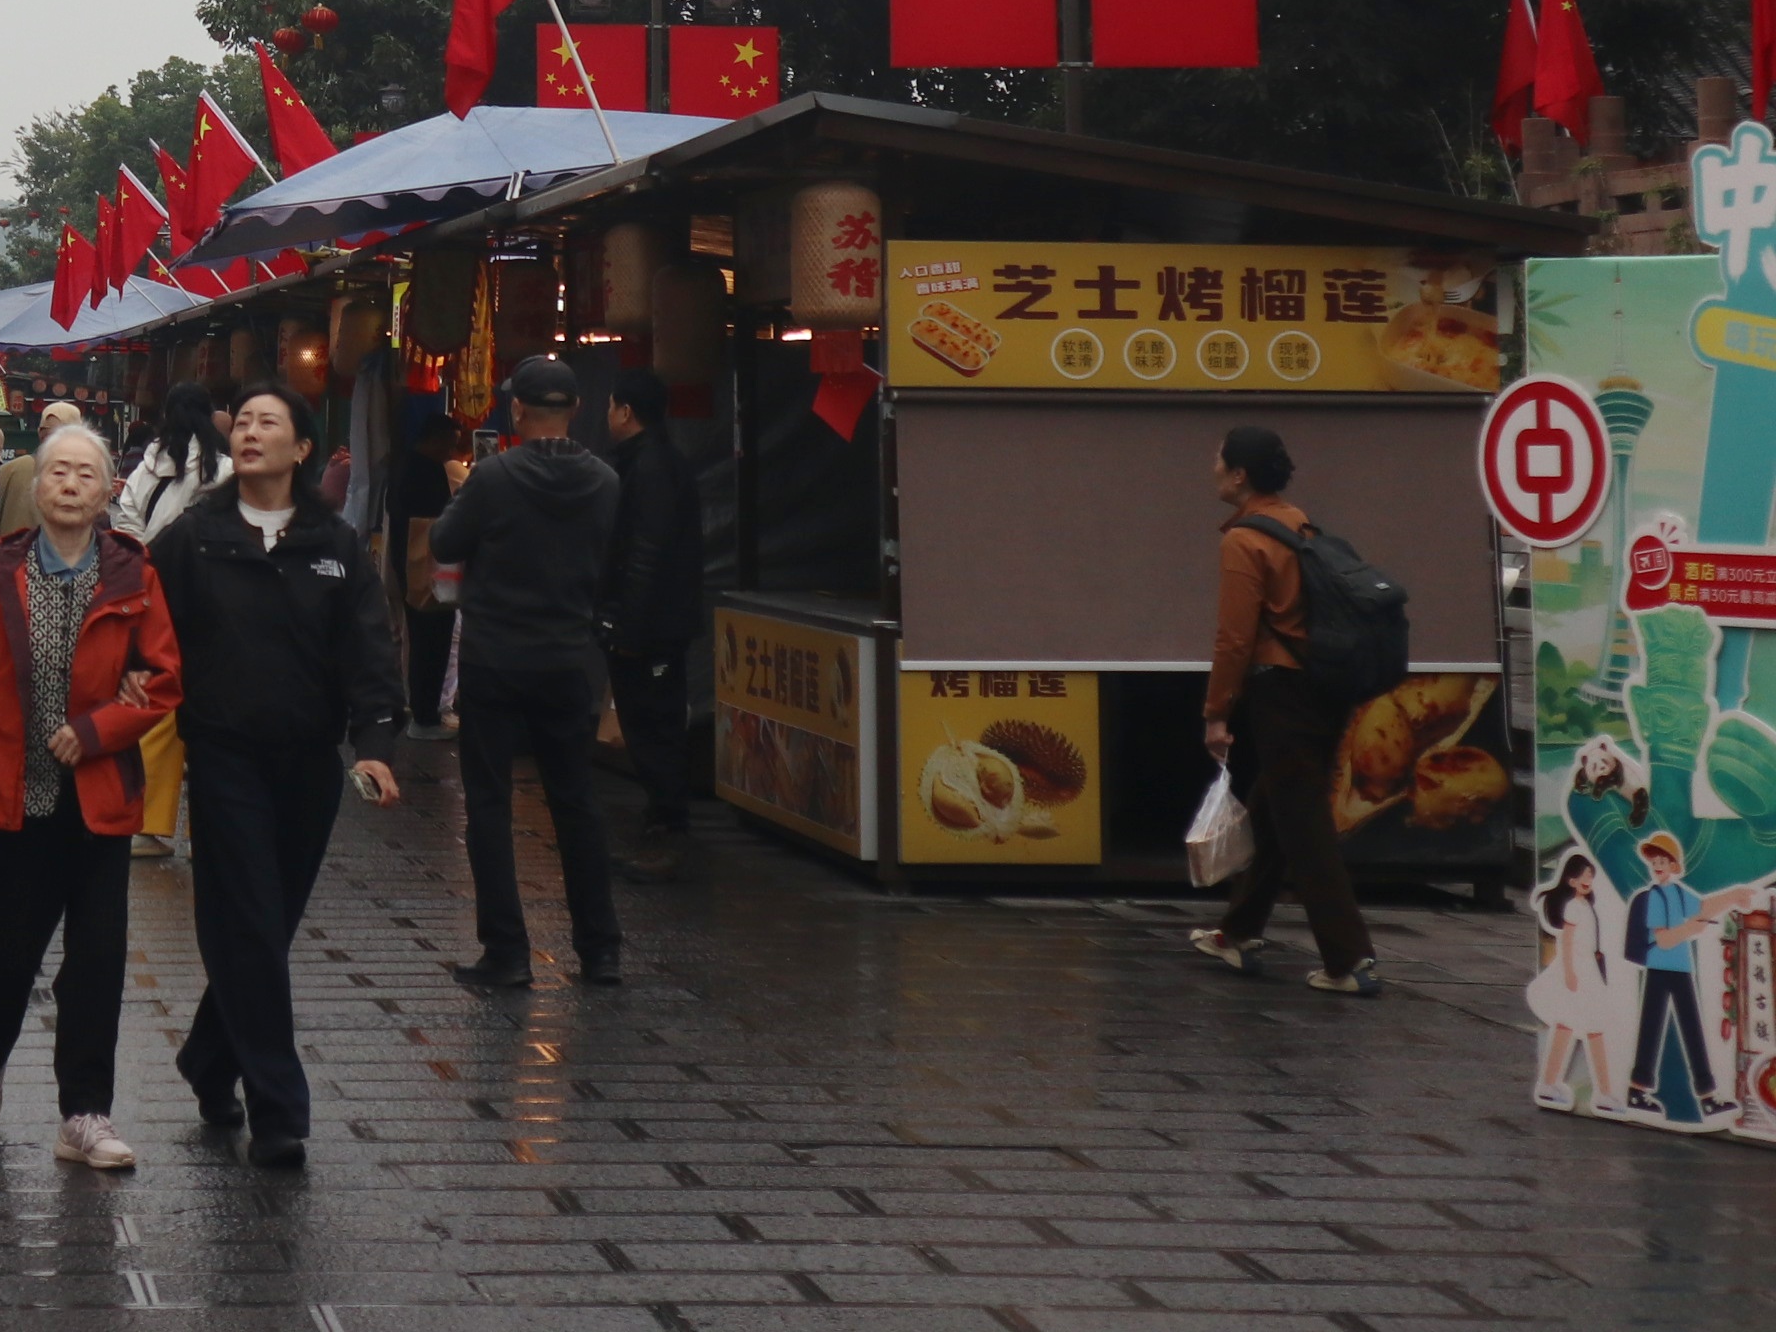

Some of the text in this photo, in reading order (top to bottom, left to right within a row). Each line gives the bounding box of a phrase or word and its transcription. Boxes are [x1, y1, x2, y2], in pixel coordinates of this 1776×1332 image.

[993, 265, 1389, 323] 芝士烤榴莲
[1, 449, 15, 459] MS
[745, 635, 820, 714] 芝士烤榴莲
